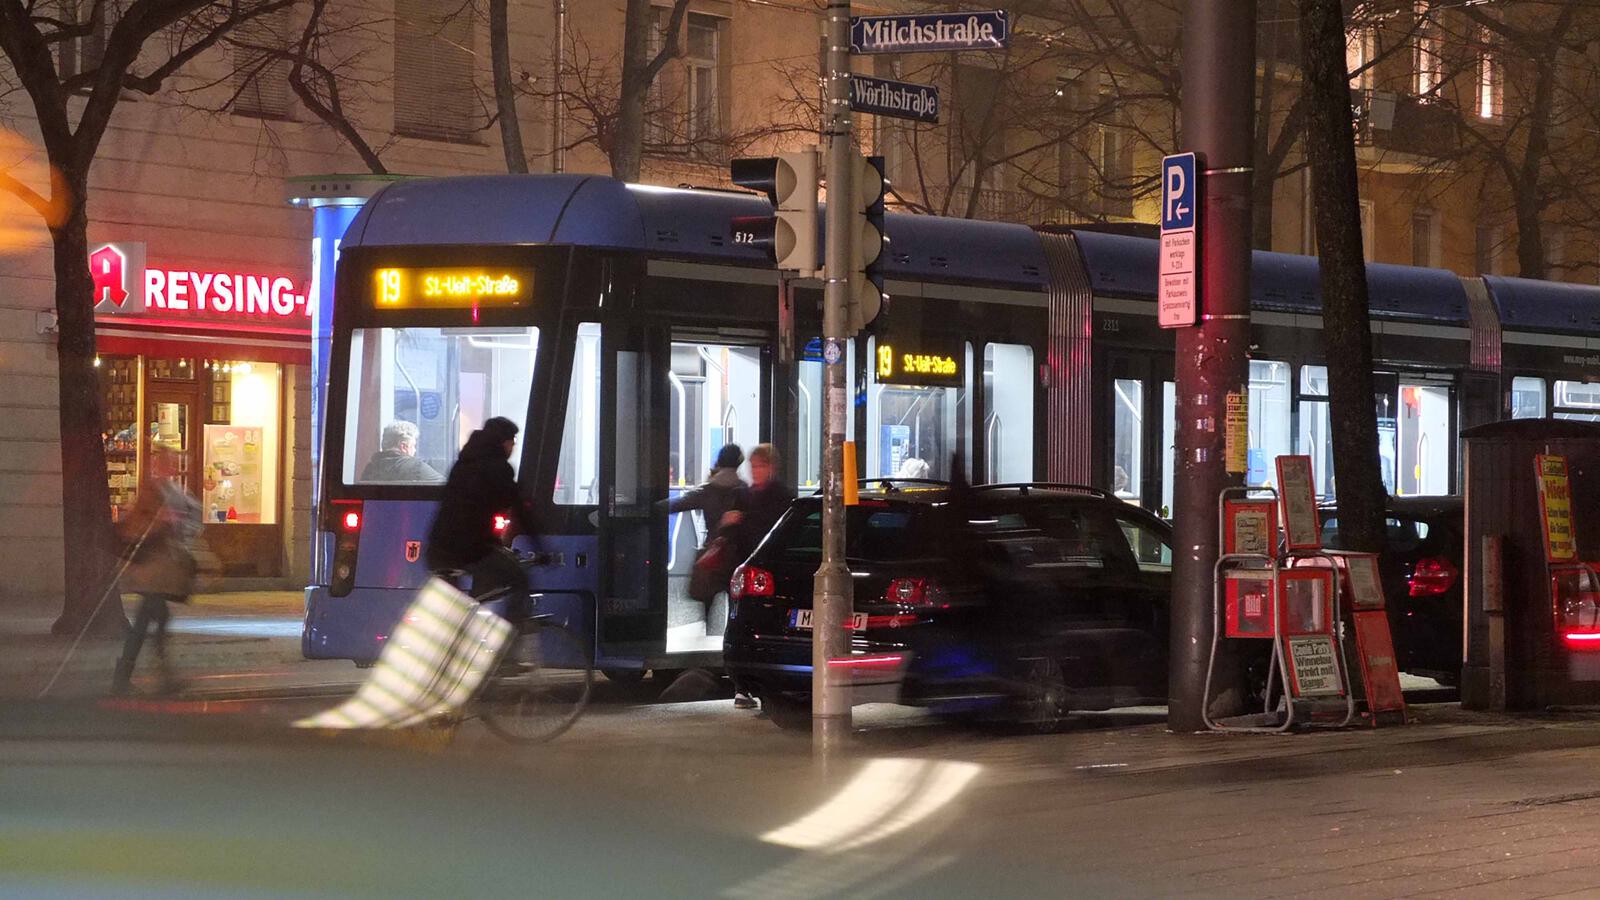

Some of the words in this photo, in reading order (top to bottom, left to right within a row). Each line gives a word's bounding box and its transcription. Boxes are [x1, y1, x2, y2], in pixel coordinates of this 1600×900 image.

[862, 16, 994, 47] Milchstraße
[854, 78, 936, 117] Wörthstraße
[735, 231, 754, 244] 512
[380, 269, 401, 303] 19
[878, 345, 892, 376] 19
[801, 611, 812, 625] M
[1295, 656, 1332, 667] Winnetou
[1297, 666, 1320, 677] trinkt
